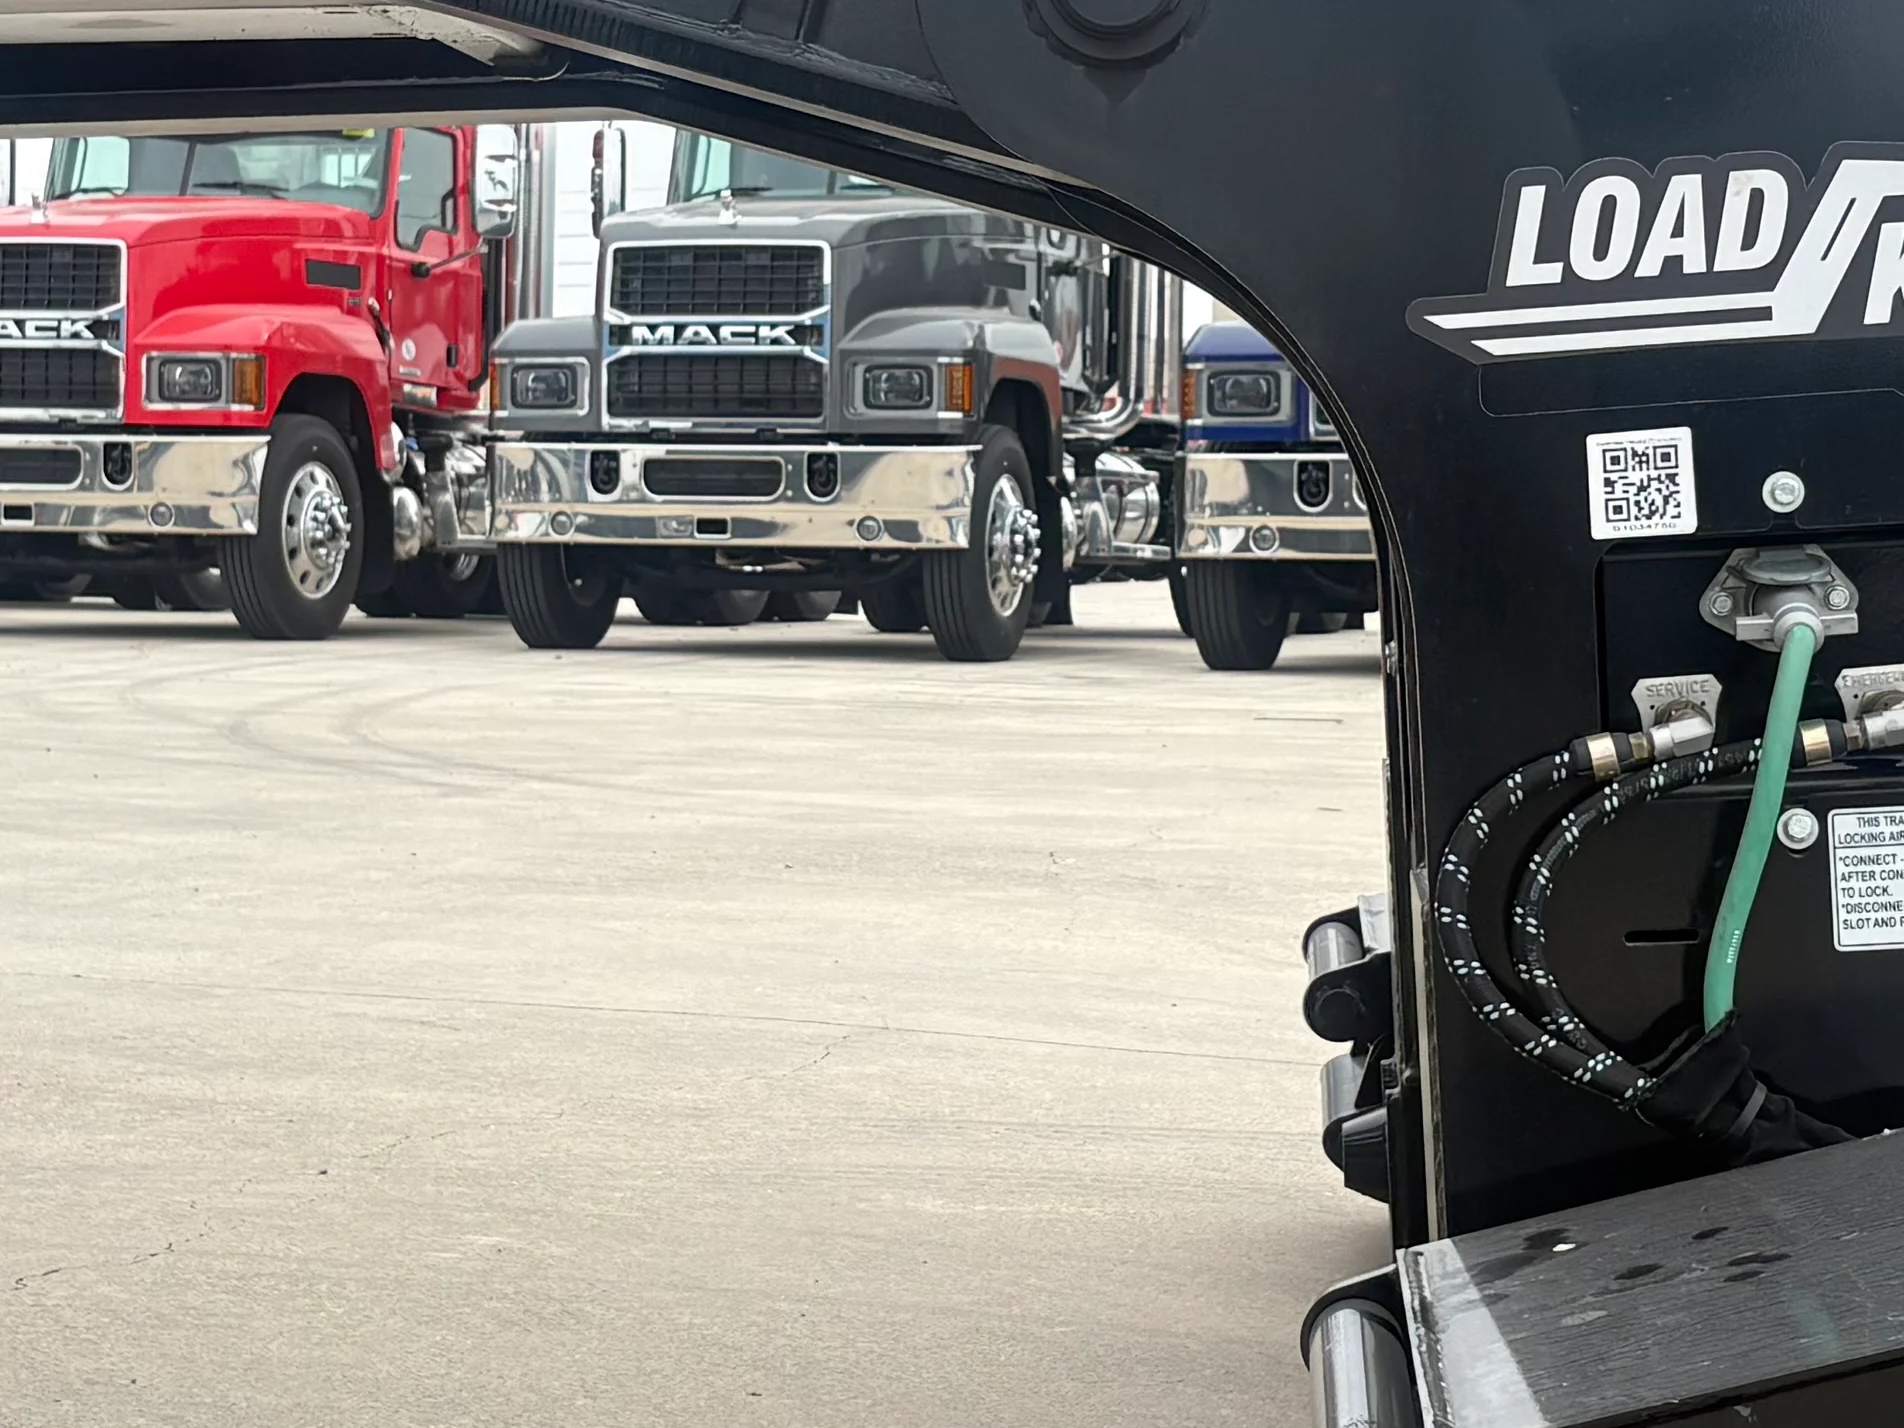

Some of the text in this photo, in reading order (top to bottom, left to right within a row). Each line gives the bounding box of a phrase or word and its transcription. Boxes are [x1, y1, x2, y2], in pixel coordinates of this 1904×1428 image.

[1505, 169, 1789, 287] LOAD
[632, 325, 796, 345] MACK
[1646, 680, 1709, 698] SERVICE
[1857, 817, 1880, 828] THIS
[1838, 832, 1886, 845] LOCKING
[1840, 871, 1876, 882] AFTER
[1841, 886, 1893, 898] TO LOCK.
[1842, 919, 1870, 930] SLOT
[1873, 917, 1896, 928] AND
